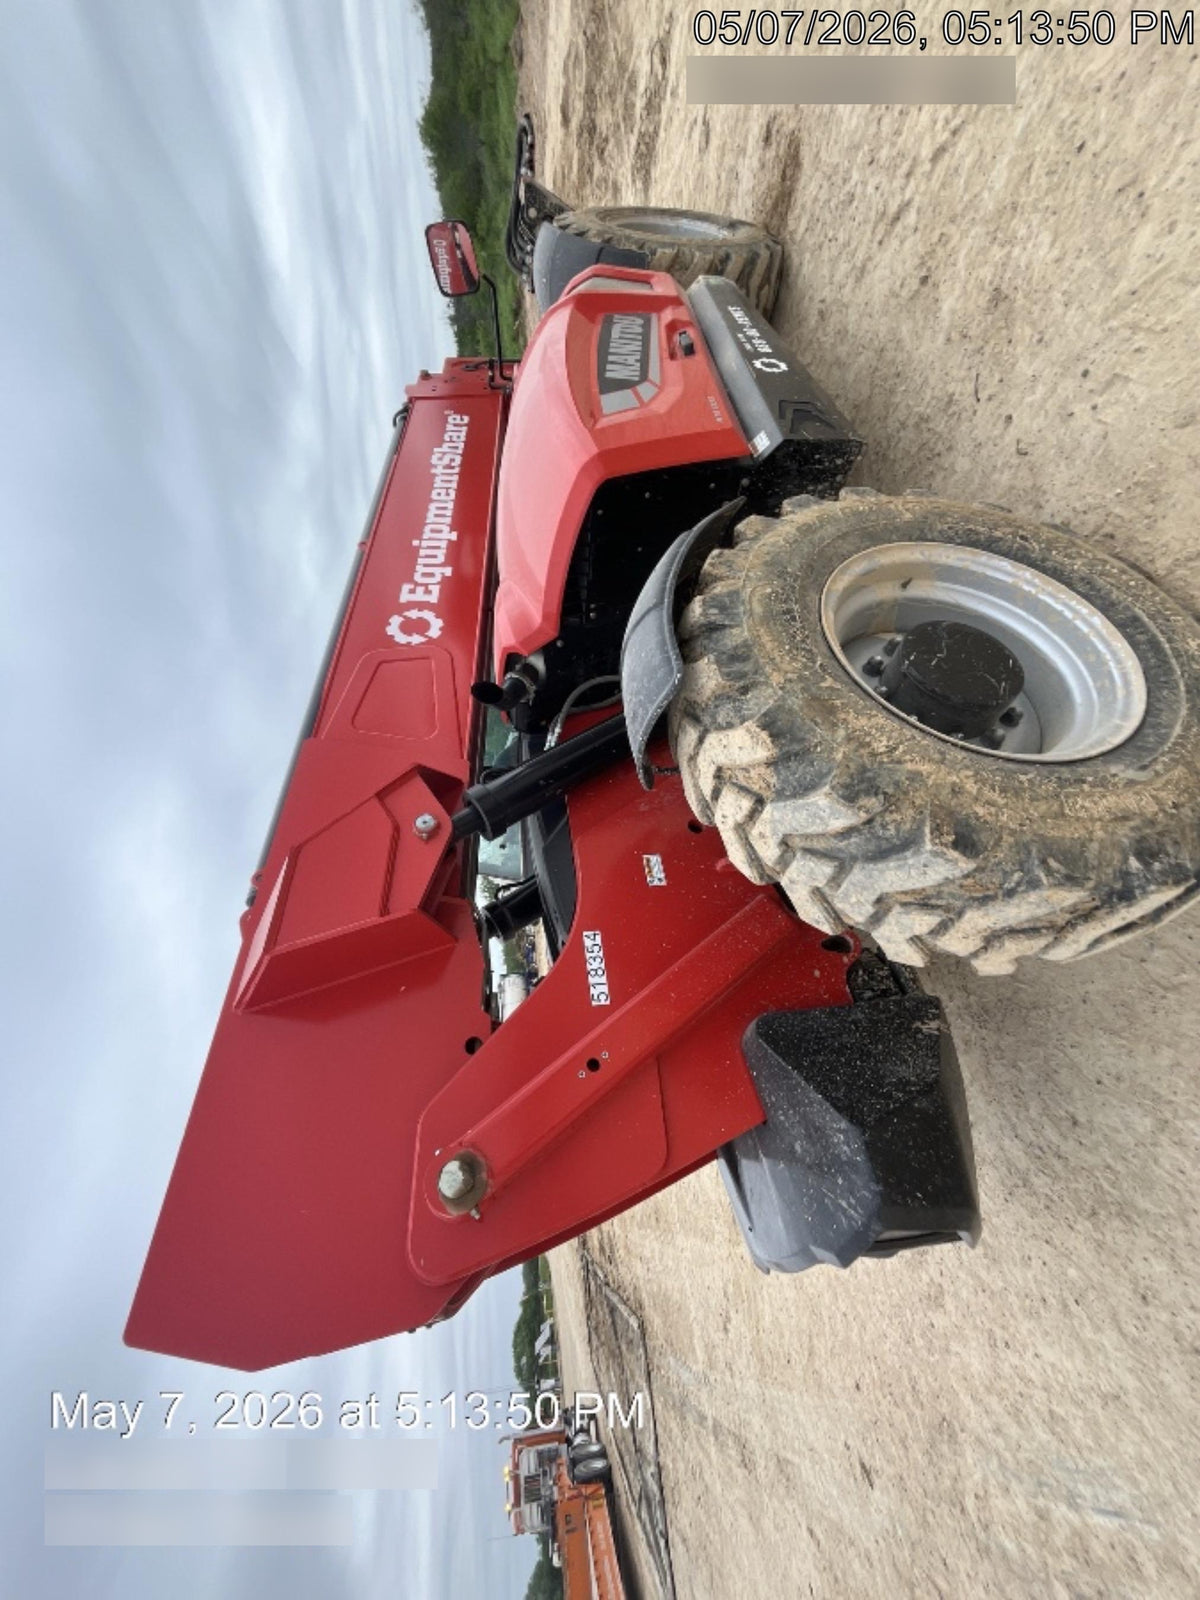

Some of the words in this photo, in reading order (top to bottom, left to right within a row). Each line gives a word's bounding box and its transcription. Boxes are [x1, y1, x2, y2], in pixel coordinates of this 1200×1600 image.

[604, 314, 645, 381] MANITOU
[398, 413, 470, 604] EquipmentShare
[583, 931, 609, 1003] 518354
